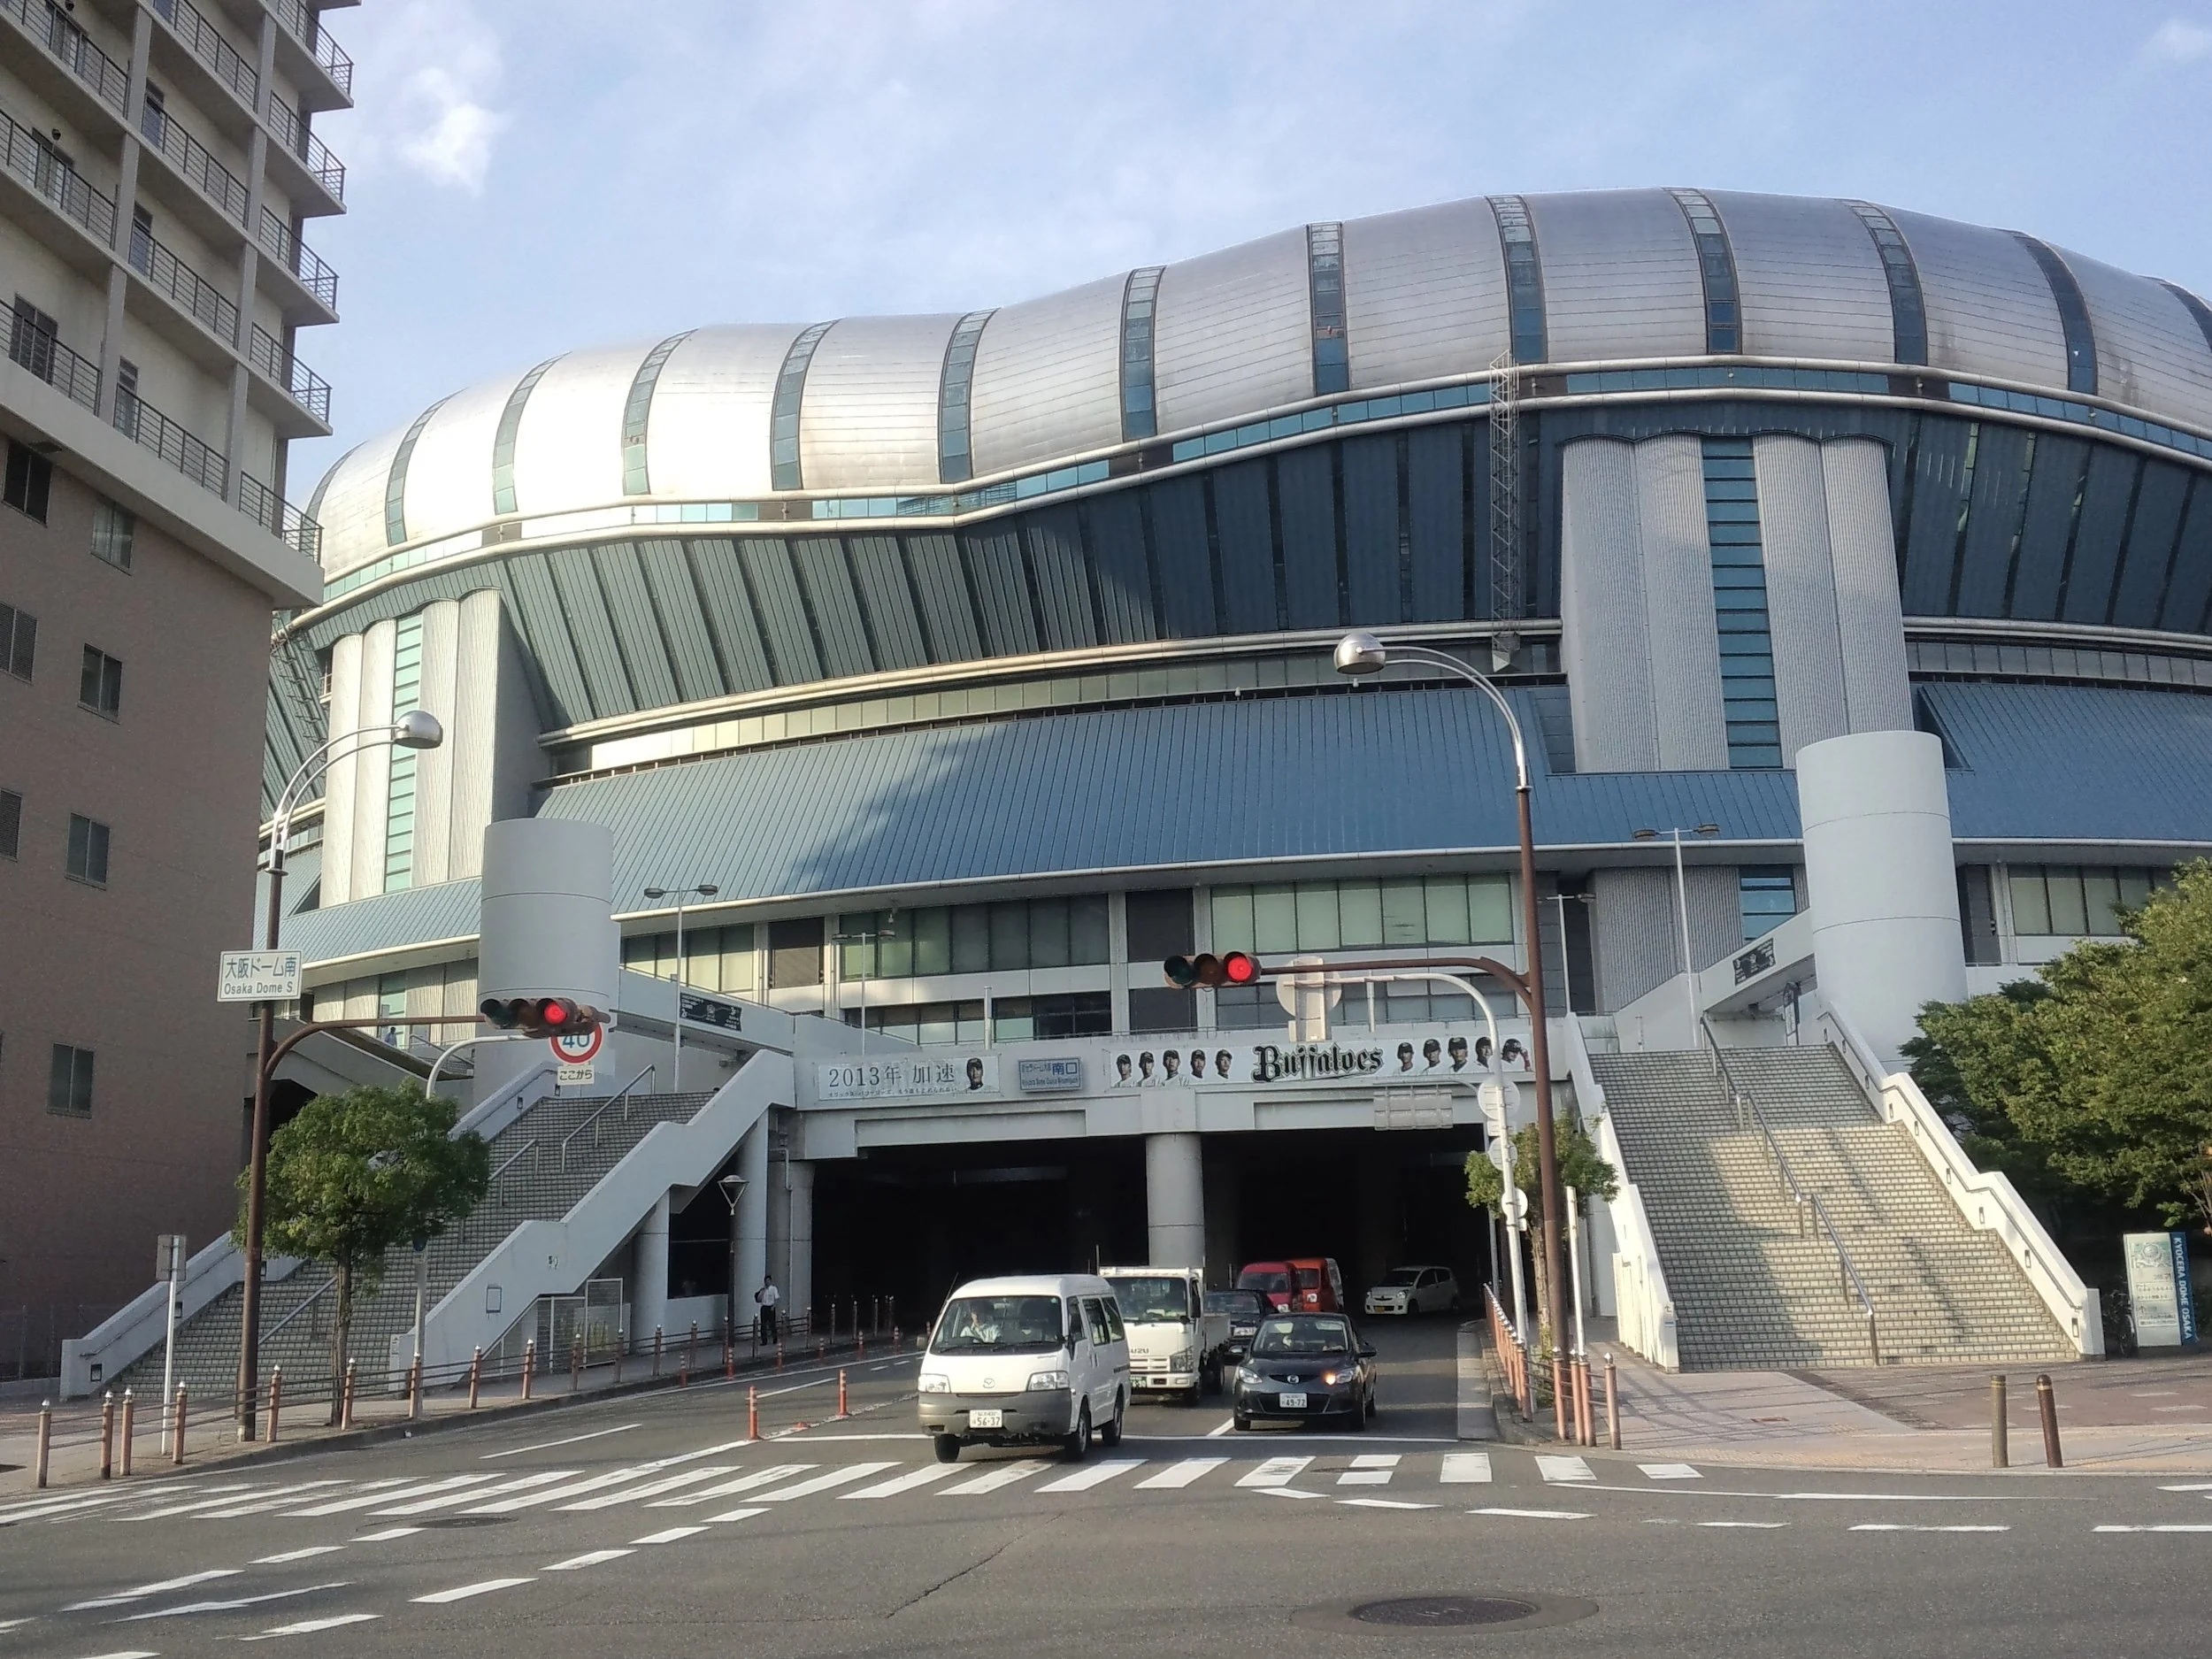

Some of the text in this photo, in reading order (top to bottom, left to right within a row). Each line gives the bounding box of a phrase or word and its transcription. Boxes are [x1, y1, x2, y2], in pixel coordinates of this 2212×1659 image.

[225, 956, 296, 979] 大阪ドーム南
[224, 980, 293, 995] Osaka Dome S
[562, 1034, 590, 1048] 40
[1251, 1042, 1384, 1083] Buffaloes
[559, 1069, 593, 1080] ここから
[828, 1065, 902, 1087] 2013年
[2174, 1237, 2193, 1340] KYOCERA DOME OSAKA
[977, 1417, 1001, 1426] 56-37
